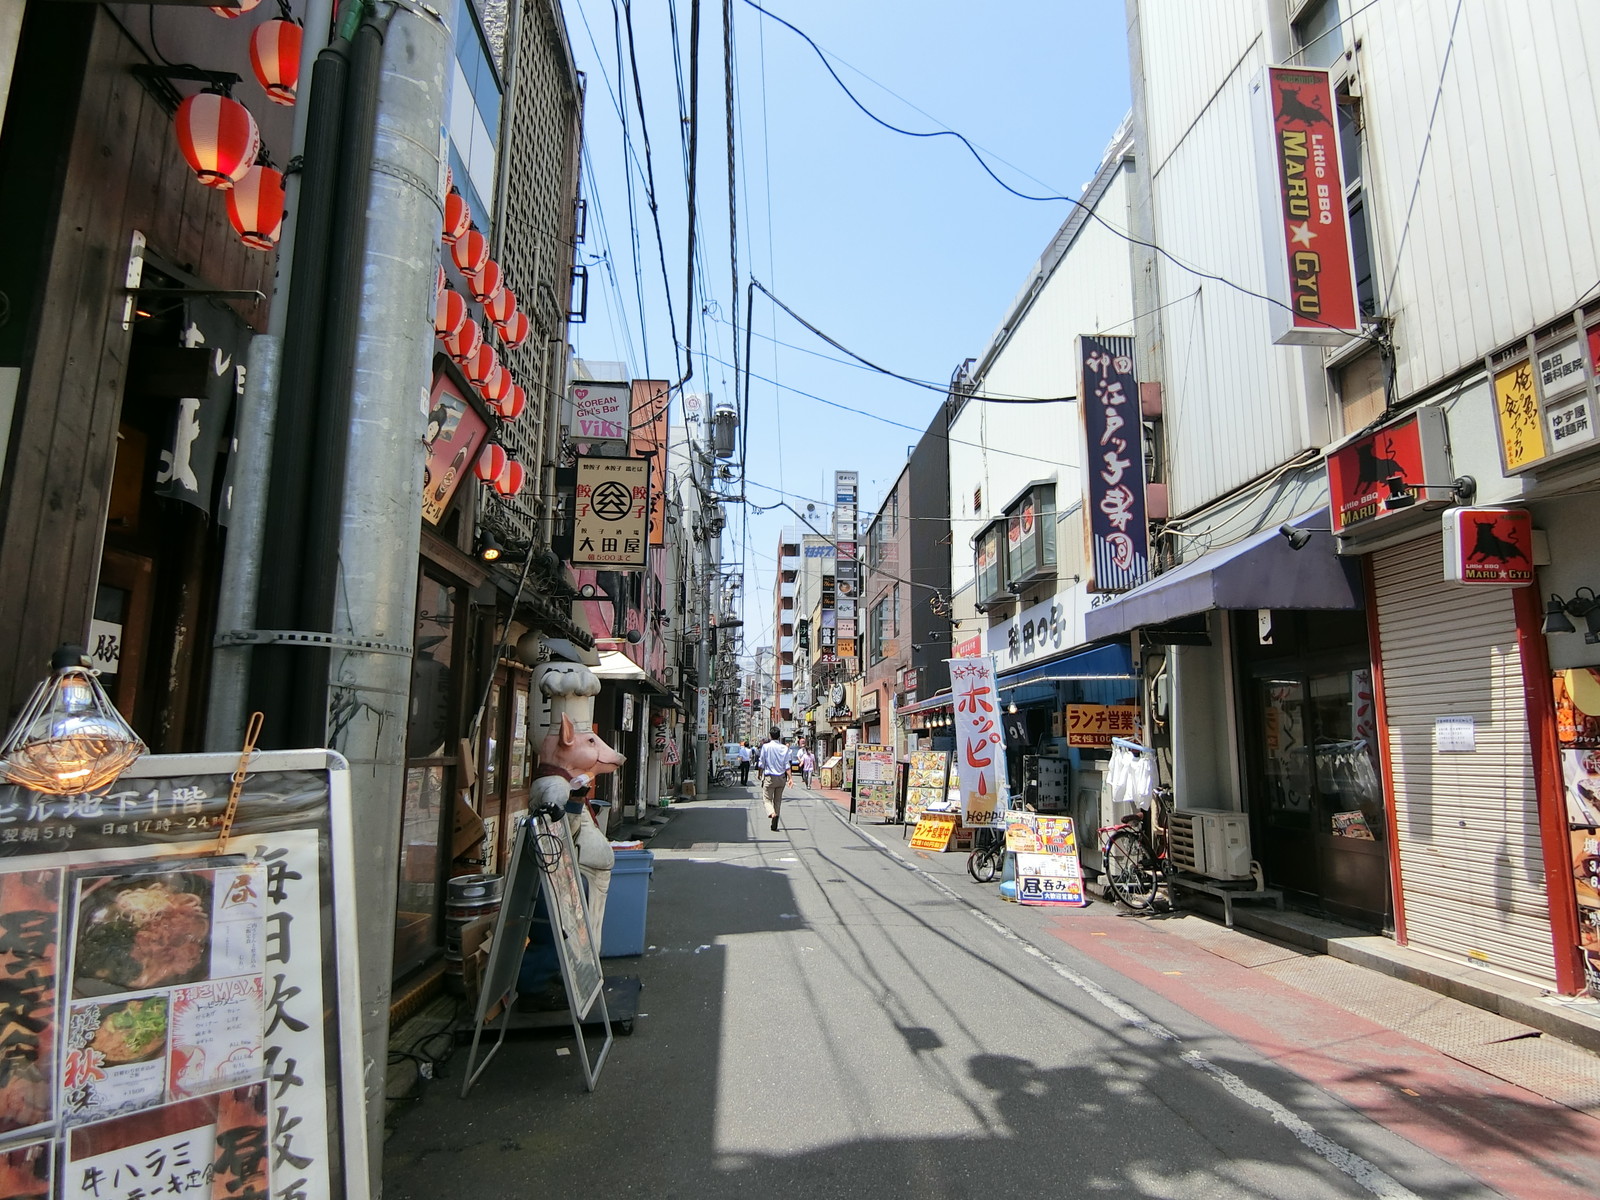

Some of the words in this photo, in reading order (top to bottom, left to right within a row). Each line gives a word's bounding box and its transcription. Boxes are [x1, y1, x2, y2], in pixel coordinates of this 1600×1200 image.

[1311, 133, 1325, 179] Little
[1282, 129, 1311, 222] MARU
[1317, 184, 1332, 225] BBQ
[1294, 250, 1320, 317] GYU
[1541, 354, 1563, 373] 島田
[1543, 358, 1584, 385] 歯科医院
[577, 396, 617, 409] KOREAN
[577, 407, 601, 417] Girl's
[602, 405, 619, 414] Bar
[1552, 404, 1586, 427] ゆず屋
[580, 419, 622, 437] ViKi
[1554, 417, 1588, 441] 製麺所
[576, 484, 592, 517] 餃子
[632, 486, 647, 519] 餃子
[1340, 500, 1359, 512] Little
[1360, 492, 1379, 504] BBQ
[1340, 503, 1376, 526] MARU
[579, 537, 641, 553] 大田屋
[1466, 569, 1497, 579] MARU
[1508, 569, 1531, 579] GYU
[92, 632, 120, 662] 豚
[958, 678, 1001, 796] ホッピー
[1022, 877, 1066, 898] 昼呑み
[82, 1141, 192, 1198] 牛ハラミ
